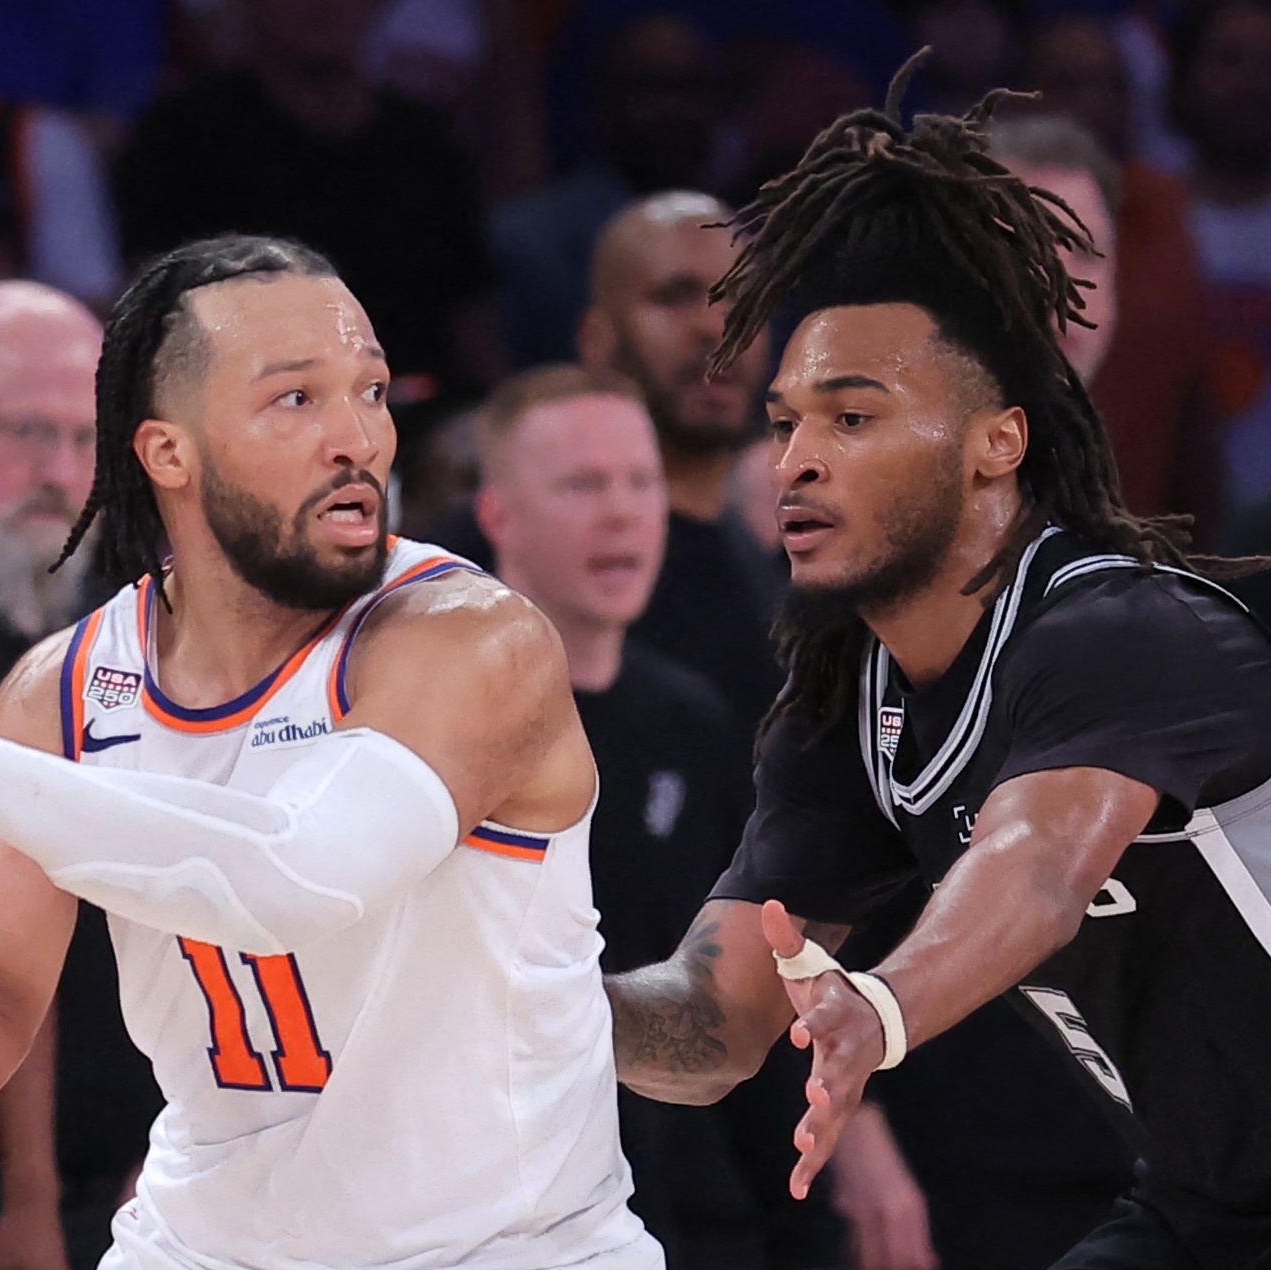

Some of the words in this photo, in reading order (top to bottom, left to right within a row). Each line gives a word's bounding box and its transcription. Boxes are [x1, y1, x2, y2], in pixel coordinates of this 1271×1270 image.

[96, 669, 137, 686] USA
[88, 686, 135, 704] 250
[882, 714, 902, 727] US
[251, 730, 275, 747] abu
[278, 717, 329, 743] dhabi
[880, 734, 900, 748] 25
[176, 935, 333, 1094] 11
